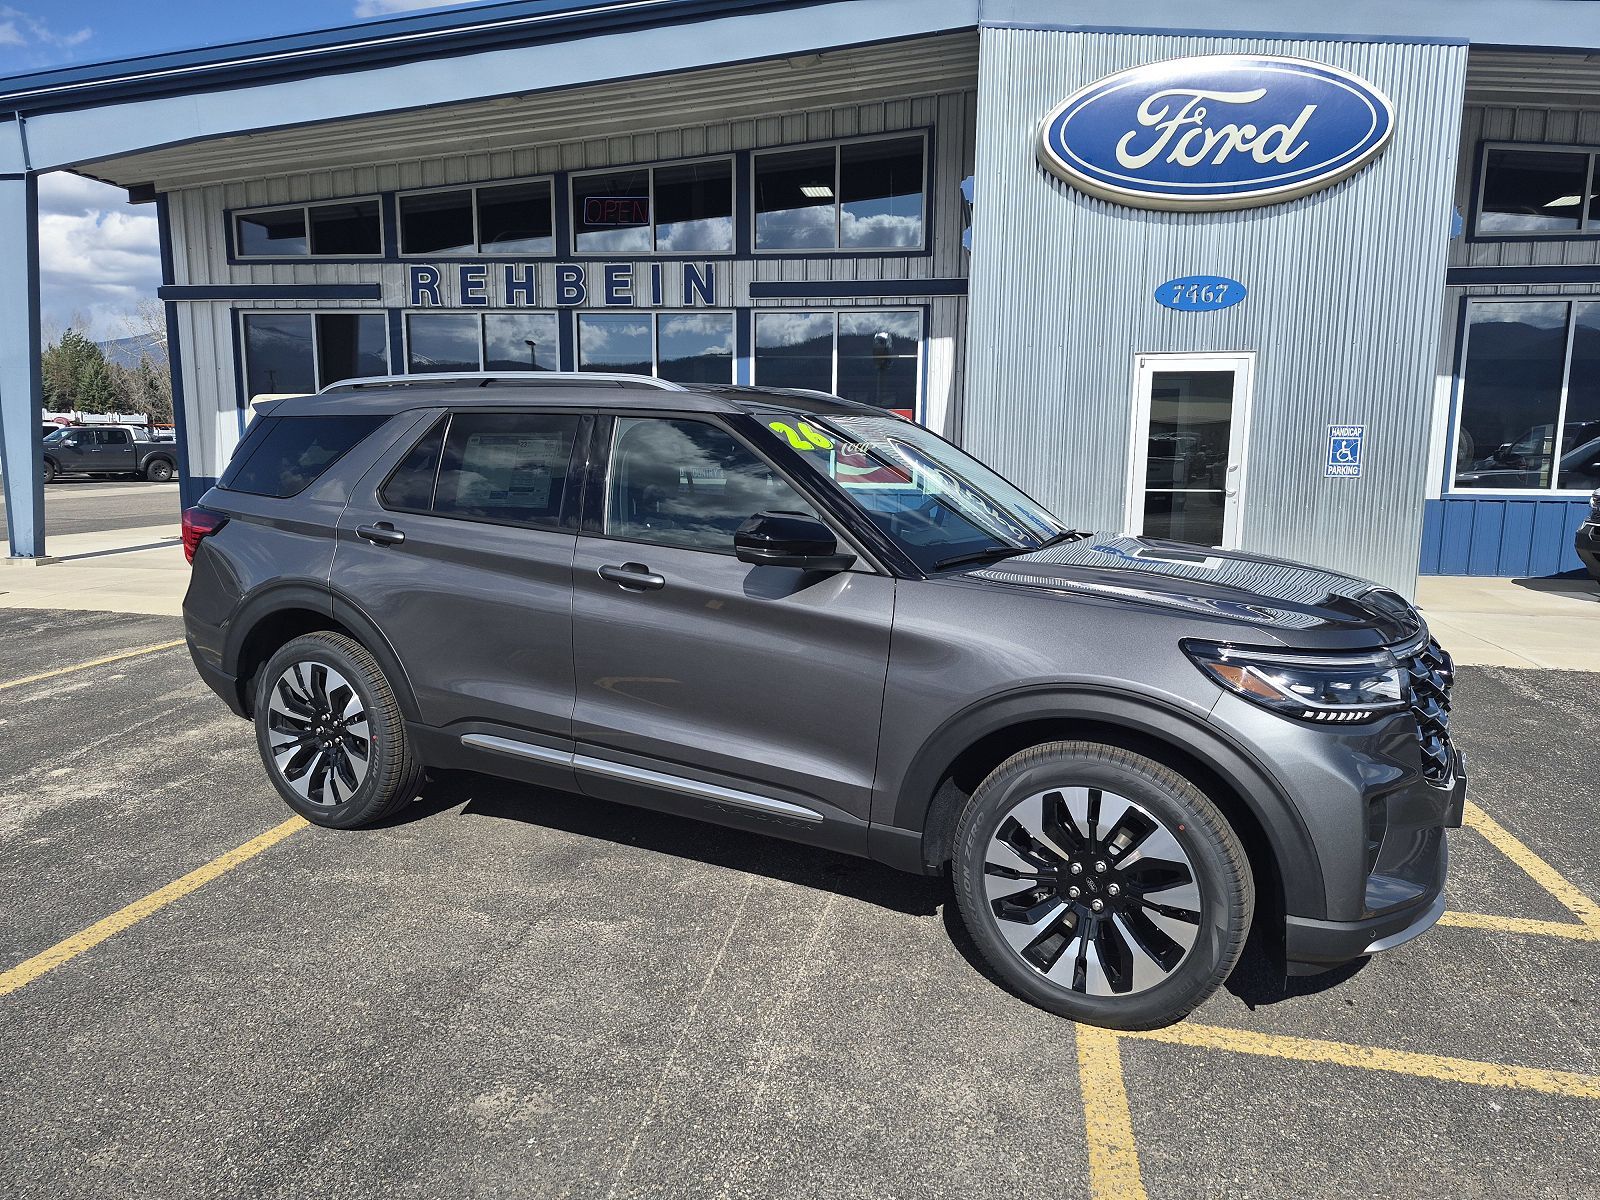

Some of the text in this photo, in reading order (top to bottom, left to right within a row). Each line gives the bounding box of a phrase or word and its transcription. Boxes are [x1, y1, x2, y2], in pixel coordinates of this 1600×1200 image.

[1115, 88, 1318, 169] Ford
[587, 200, 648, 222] OPEN
[409, 262, 716, 306] REHBEIN
[1172, 284, 1230, 304] 7467
[768, 421, 834, 451] 26
[1331, 427, 1362, 437] HANDICAP
[1328, 466, 1358, 475] PARKING
[964, 812, 985, 860] ZERO
